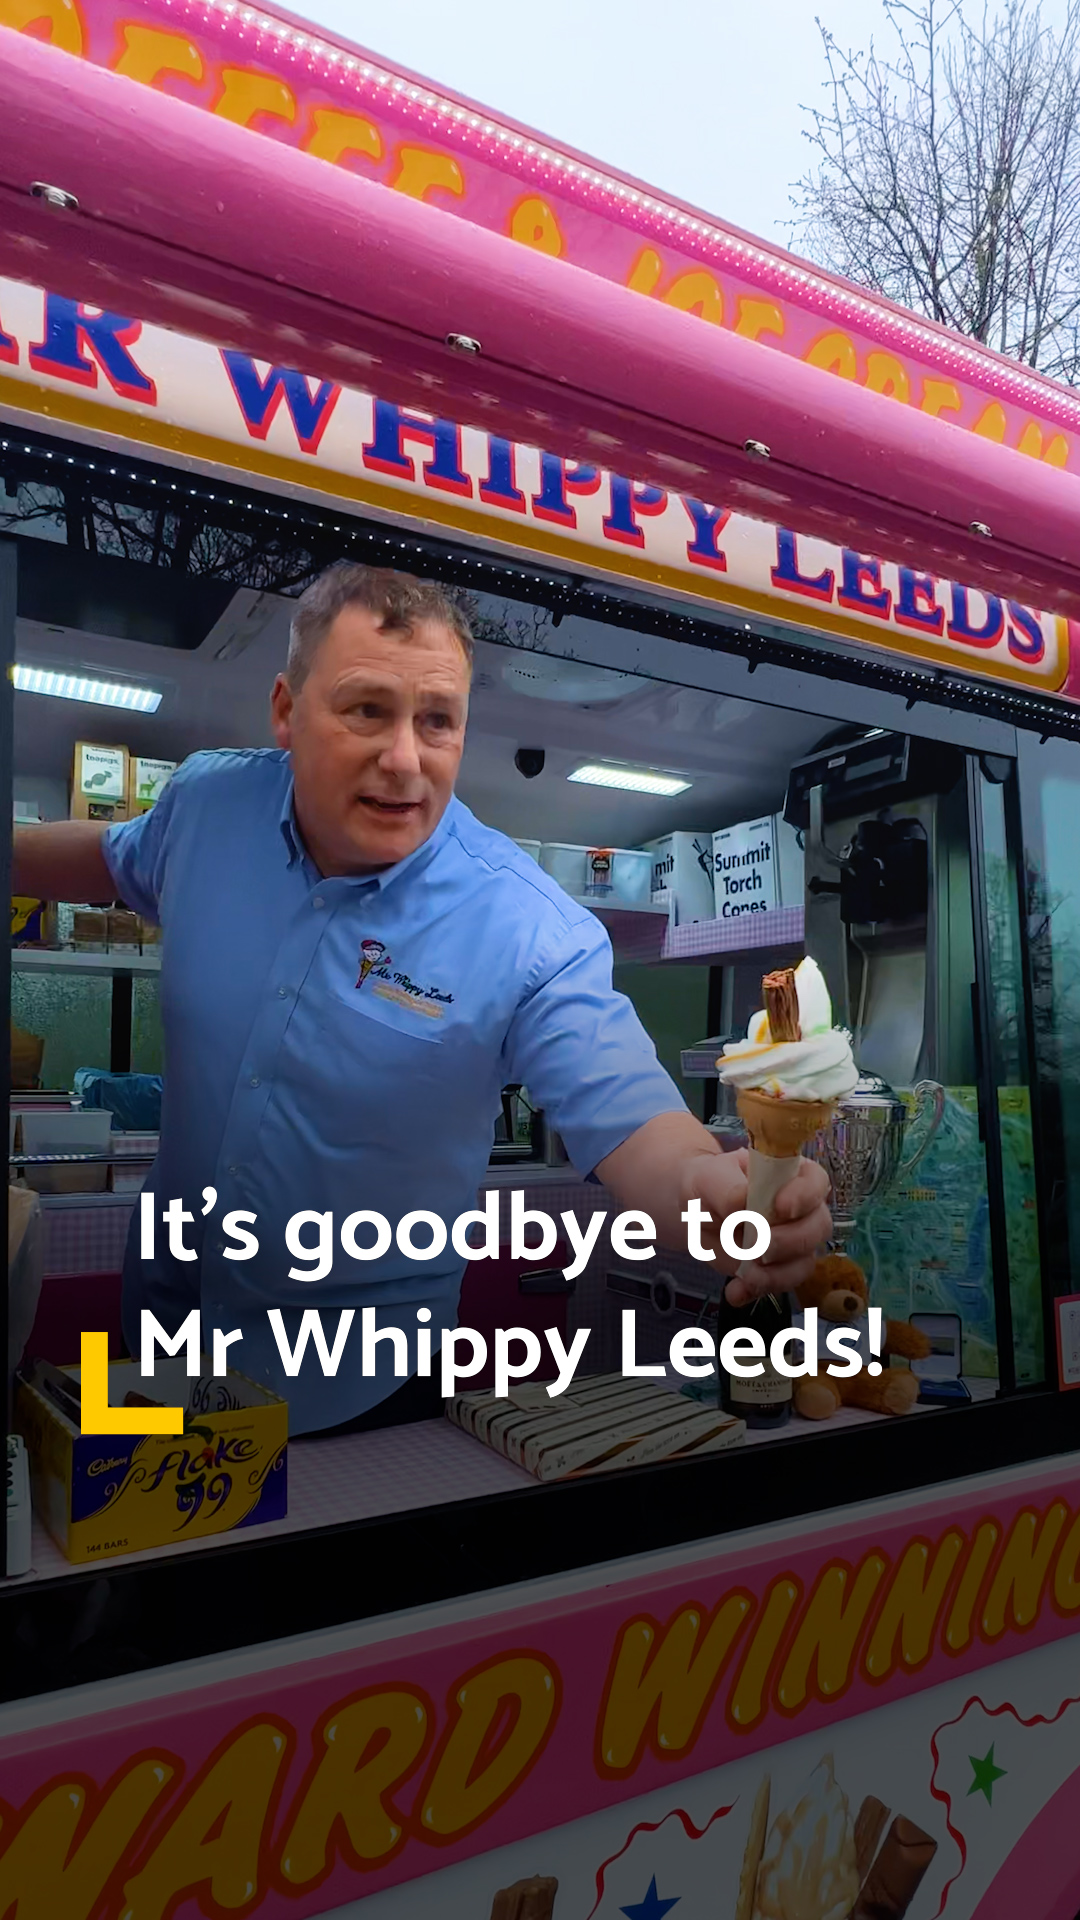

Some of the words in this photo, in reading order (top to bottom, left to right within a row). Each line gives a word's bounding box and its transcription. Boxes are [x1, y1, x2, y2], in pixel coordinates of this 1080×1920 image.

[0, 289, 157, 407] R
[218, 348, 732, 573] WHIPPY
[770, 526, 1046, 664] LEEDS
[715, 841, 771, 873] Summit
[723, 868, 762, 895] Torch
[722, 900, 767, 918] Cones
[141, 1436, 264, 1493] flake
[173, 1472, 232, 1533] 99
[86, 1544, 101, 1554] 144
[104, 1538, 129, 1551] BARS
